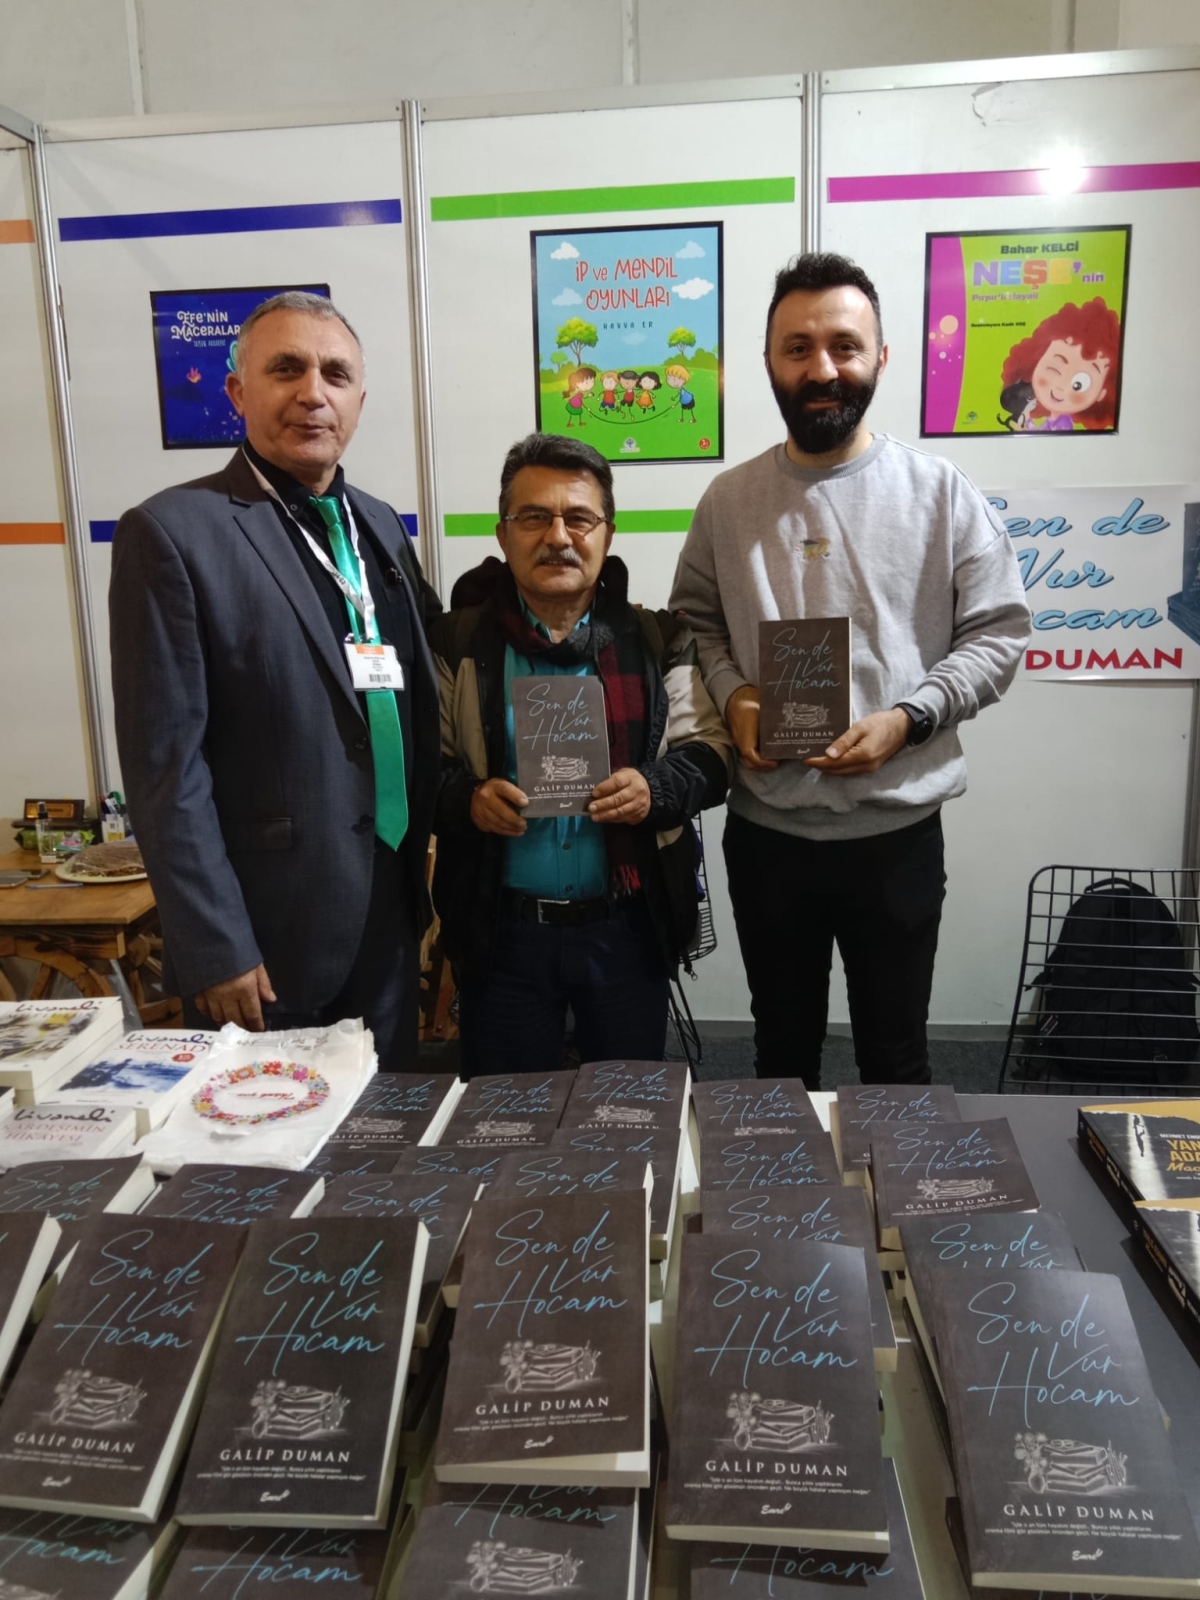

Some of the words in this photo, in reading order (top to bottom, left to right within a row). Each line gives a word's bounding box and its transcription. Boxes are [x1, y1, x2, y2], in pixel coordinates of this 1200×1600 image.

[1000, 244, 1038, 254] Bahar
[1041, 240, 1079, 253] KELCİ
[1091, 497, 1171, 536] de
[772, 627, 809, 662] Sen
[811, 629, 833, 660] de
[1025, 647, 1183, 670] DUMAN
[766, 660, 840, 700] Hocam
[526, 683, 562, 717] Sen
[567, 686, 588, 715] de
[523, 714, 598, 754] Hocam
[773, 731, 799, 739] GALİP
[533, 783, 561, 792] GALİP
[564, 783, 595, 791] DUMAN
[114, 1043, 207, 1052] SERENAD
[480, 1078, 526, 1099] Sen
[526, 1078, 553, 1096] de
[594, 1063, 635, 1084] Sen
[641, 1068, 668, 1087] de
[579, 1081, 675, 1104] Hocam
[710, 1084, 754, 1104] Sen
[762, 1084, 788, 1103] de
[855, 1088, 901, 1110] Sen
[908, 1092, 937, 1109] de
[463, 1095, 556, 1120] Hocam
[708, 1102, 807, 1127] Hocam
[893, 1127, 954, 1150] Sen
[956, 1127, 989, 1149] de
[720, 1140, 775, 1167] Sen
[781, 1141, 813, 1165] de
[887, 1149, 1008, 1178] Hocam
[181, 1170, 242, 1198] Sen
[246, 1178, 289, 1198] de
[516, 1156, 578, 1186] Sen
[583, 1161, 620, 1188] de
[712, 1165, 828, 1191] Hocam
[342, 1180, 402, 1211] Sen
[408, 1184, 449, 1213] de
[905, 1201, 948, 1210] GALİP
[956, 1194, 1009, 1207] DUMAN
[728, 1195, 795, 1230] Sen
[801, 1197, 840, 1229] de
[495, 1208, 568, 1266] Sen
[572, 1209, 616, 1263] de
[930, 1223, 1007, 1260] Sen
[1009, 1225, 1049, 1258] de
[89, 1229, 162, 1286] Sen
[163, 1242, 214, 1295] de
[263, 1231, 337, 1296] Sen
[339, 1239, 384, 1298] de
[711, 1248, 788, 1308] Sen
[794, 1261, 840, 1314] de
[473, 1264, 629, 1338] Hocam
[968, 1281, 1052, 1344] Sen
[1060, 1293, 1105, 1349] de
[53, 1291, 194, 1366] Hocam
[235, 1296, 386, 1377] Hocam
[773, 1306, 849, 1343] Vur
[693, 1311, 859, 1389] Hocam
[1047, 1341, 1122, 1379] Vur
[967, 1347, 1140, 1429] Hocam
[475, 1400, 532, 1415] GALİP
[540, 1397, 610, 1411] DUMAN
[14, 1431, 66, 1447] GALİP
[71, 1437, 136, 1454] DUMAN
[219, 1446, 275, 1461] GALİP
[281, 1449, 351, 1463] DUMAN
[705, 1458, 765, 1473] GALİP
[774, 1462, 848, 1477] DUMAN
[1003, 1502, 1066, 1517] GALİP
[1076, 1506, 1154, 1521] DUMAN
